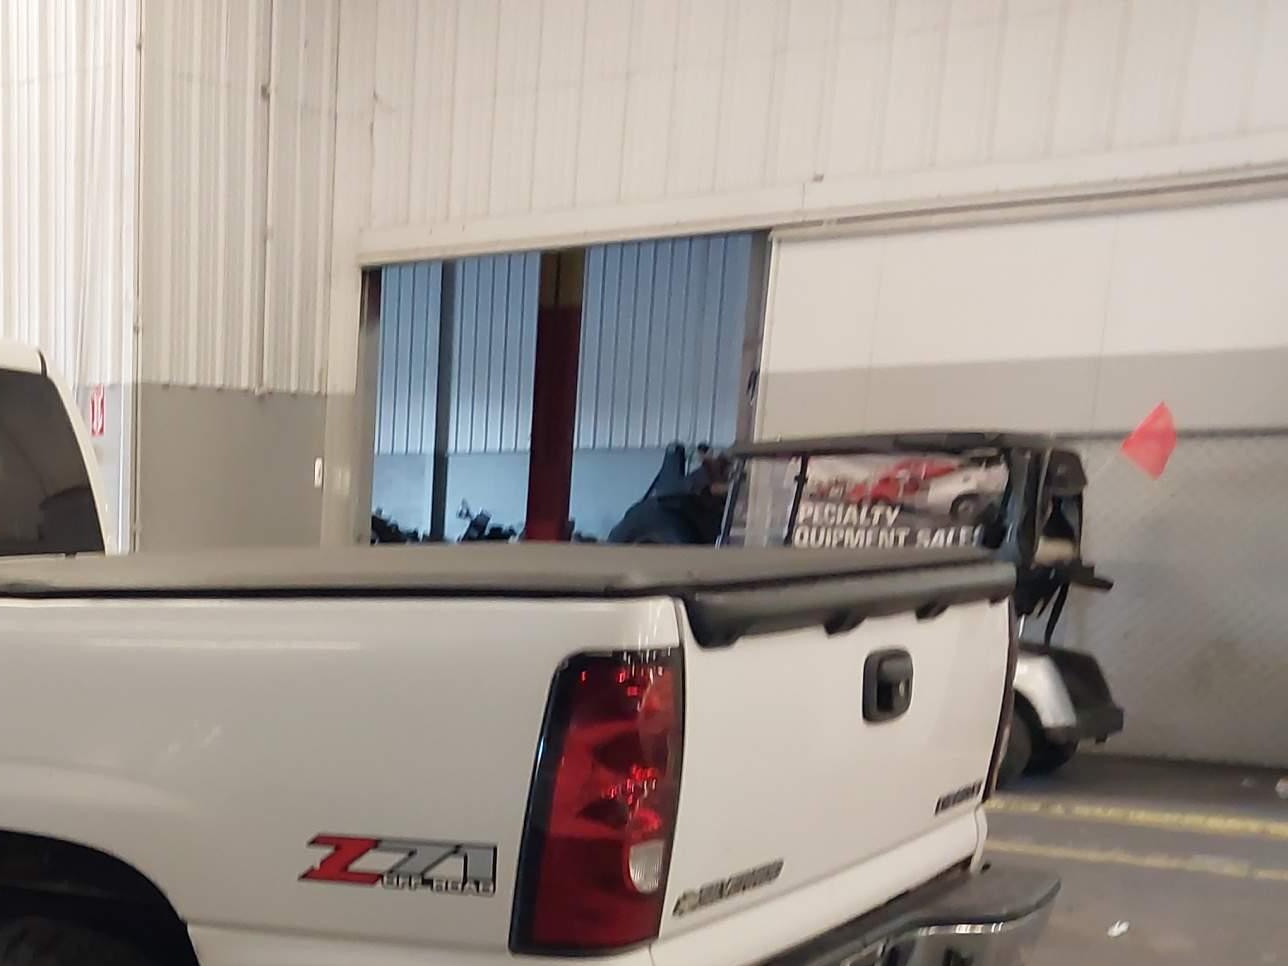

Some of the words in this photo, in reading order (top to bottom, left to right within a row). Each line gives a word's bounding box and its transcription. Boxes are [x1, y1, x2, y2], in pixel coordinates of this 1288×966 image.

[798, 503, 901, 526] PECIALTY
[794, 525, 910, 547] QUIPMENT
[297, 832, 498, 894] Z71
